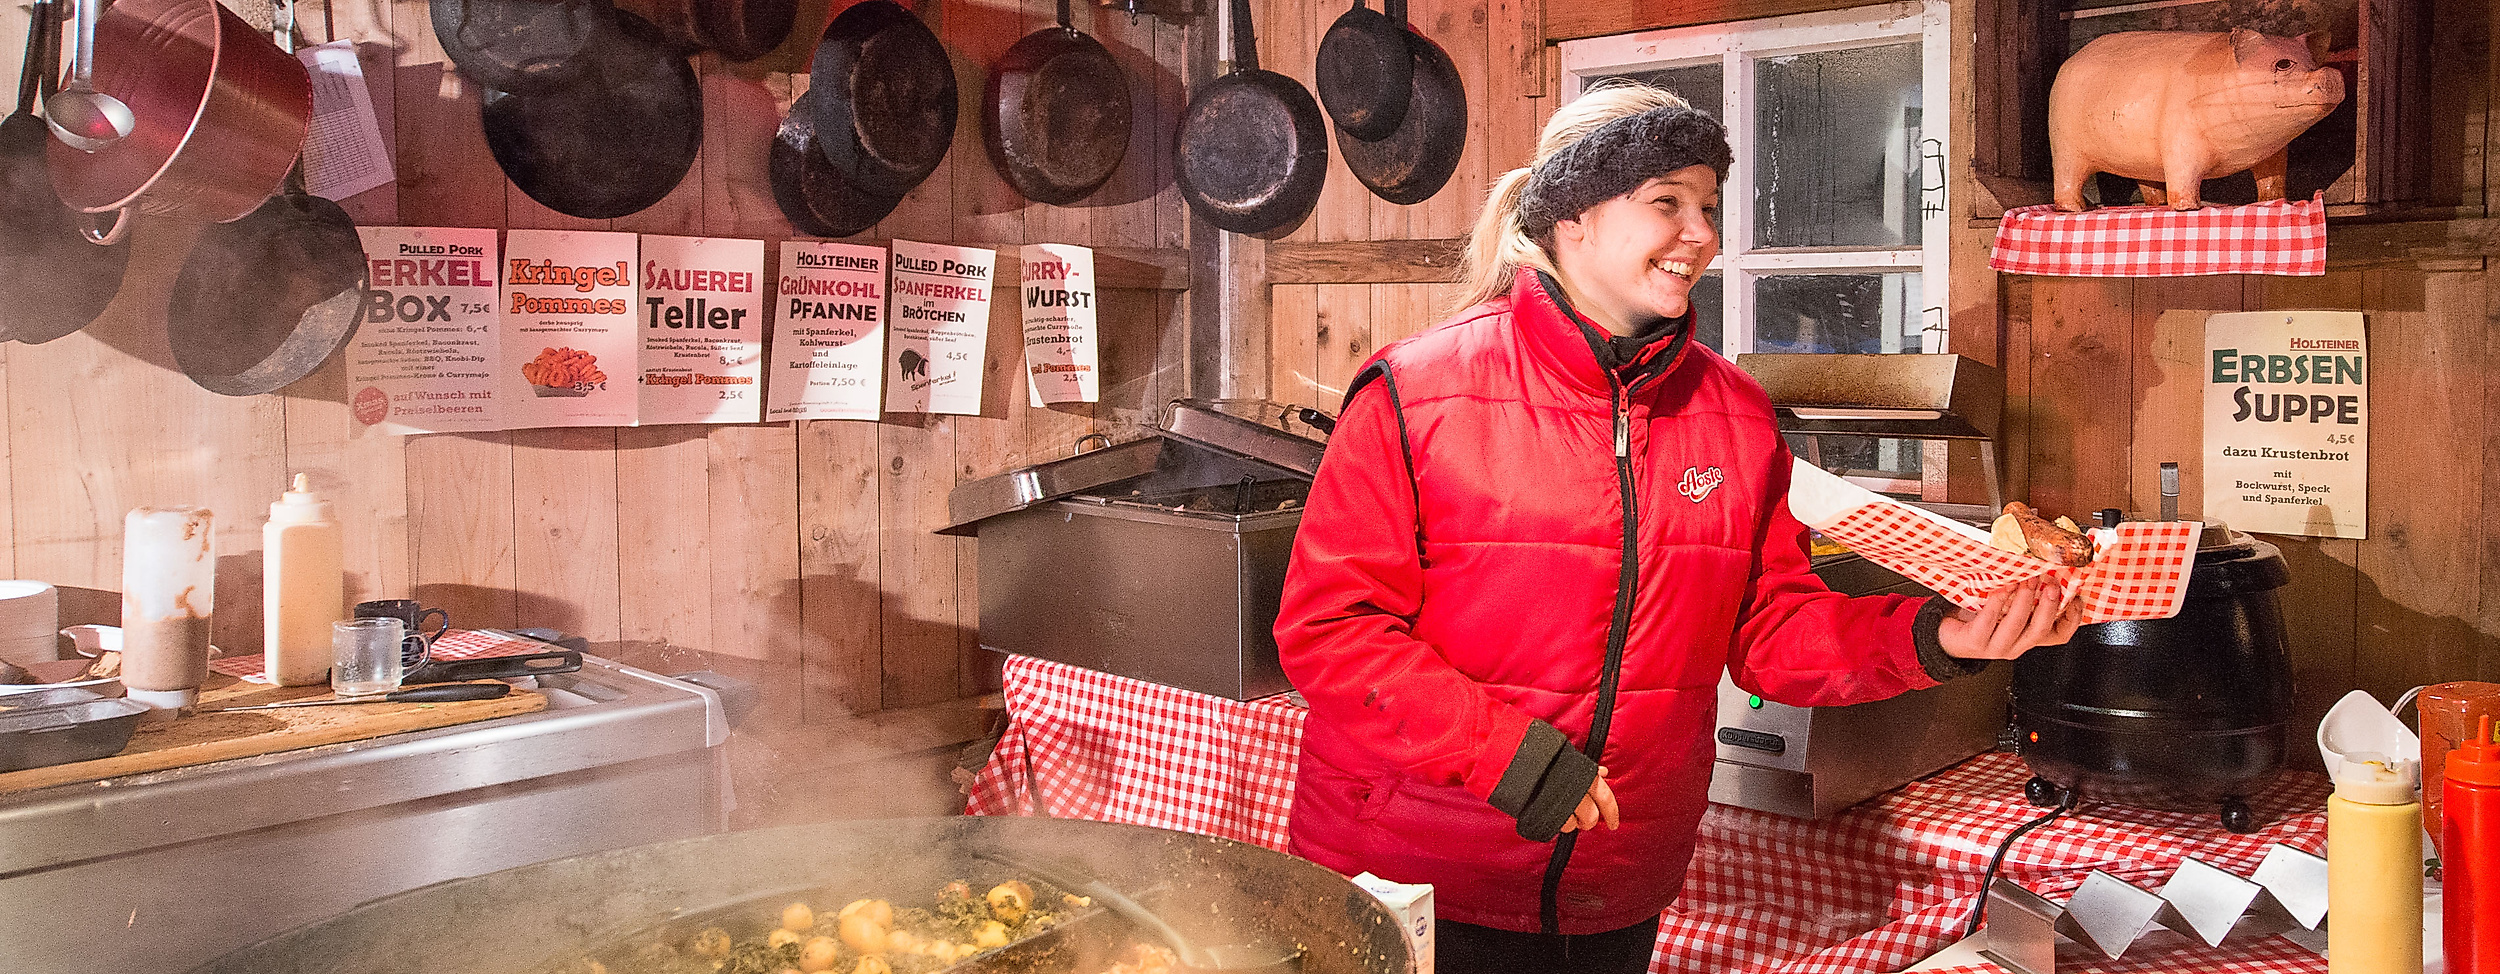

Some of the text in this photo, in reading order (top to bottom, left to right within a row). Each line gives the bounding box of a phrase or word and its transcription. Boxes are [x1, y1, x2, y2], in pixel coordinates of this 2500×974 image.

[399, 243, 484, 256] PULLED PORK
[365, 253, 493, 287] ERKEL
[796, 252, 878, 270] HOLSTEINER
[895, 253, 987, 277] PULLED PORK
[508, 258, 630, 292] Kringel
[644, 259, 753, 293] SAUEREI
[780, 275, 880, 299] GRÜNKOHL
[893, 276, 987, 302] SPANFERKEL
[367, 289, 490, 323] BOX 7,5€
[511, 292, 627, 315] Pommes
[923, 298, 935, 308] im
[1026, 286, 1091, 309] WURST
[646, 296, 747, 330] Teller
[789, 298, 877, 322] PFANNE
[902, 304, 966, 323] BRÖTCHEN
[806, 327, 857, 338] Spanferkel,
[2290, 337, 2359, 350] HOLSTEINER
[812, 350, 829, 358] und
[789, 361, 858, 371] Kartoffeleinlage
[2212, 349, 2363, 385] ERBSEN
[646, 373, 693, 388] Kringel
[694, 373, 753, 386] Pommes
[414, 389, 465, 400] Wunsch
[469, 389, 492, 399] mit
[394, 403, 484, 416] Preiselbeeren
[2232, 386, 2359, 425] SUPPE
[2326, 433, 2355, 445] 4,5€
[2223, 446, 2350, 461] dazu Krustenbrot
[2273, 469, 2292, 479] mit
[2235, 480, 2331, 494] Bockwurst, Speck
[2242, 493, 2323, 506] und Spanferkel
